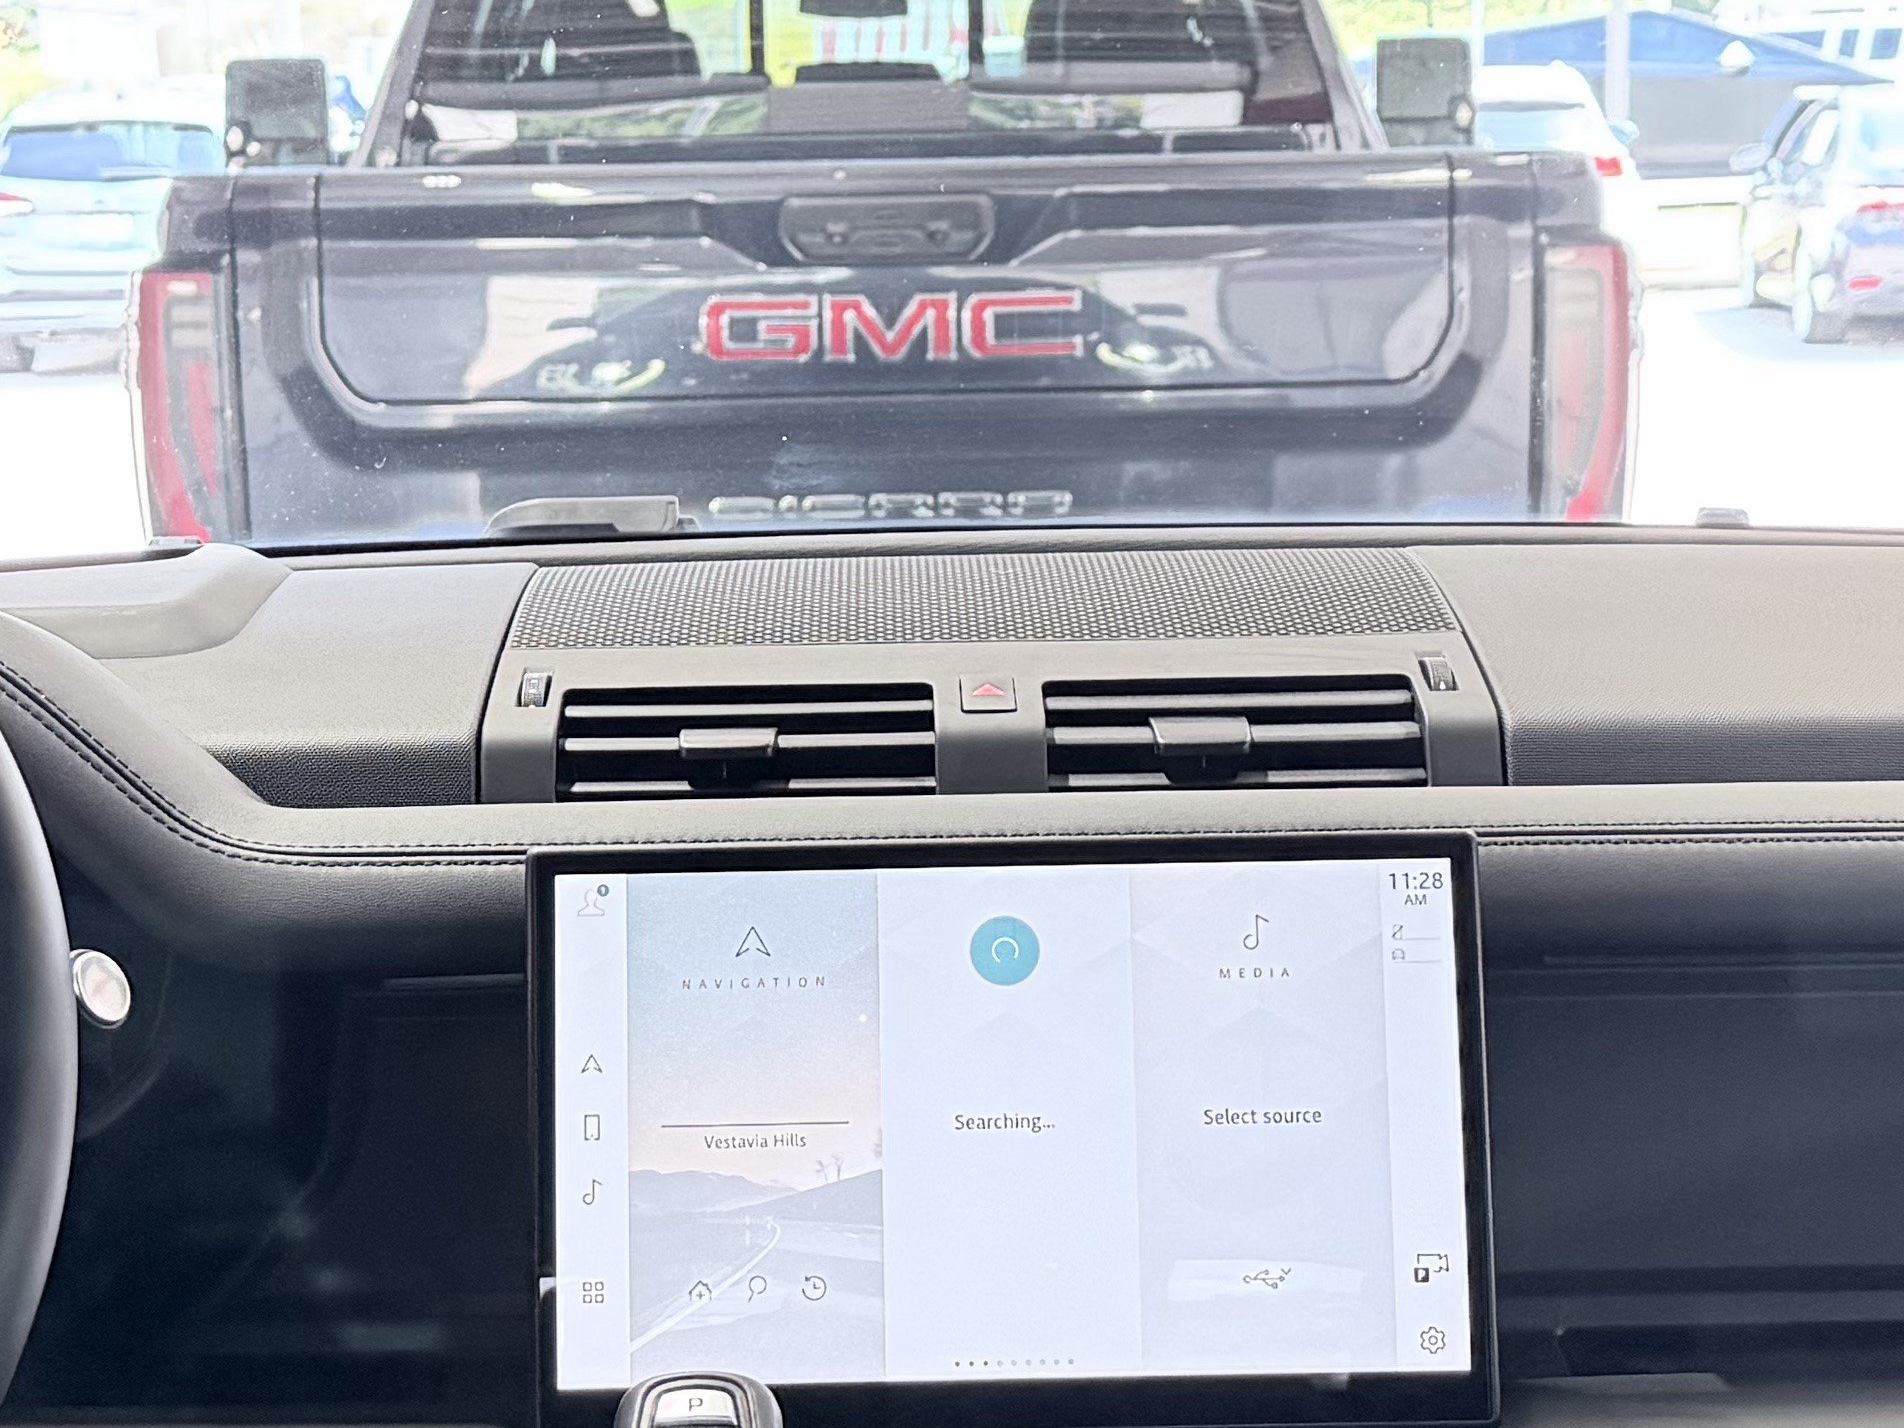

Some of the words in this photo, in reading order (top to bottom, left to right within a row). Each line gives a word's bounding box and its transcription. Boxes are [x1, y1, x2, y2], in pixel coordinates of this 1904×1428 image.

[700, 290, 1084, 362] GMC
[1388, 871, 1444, 890] 11:28
[1404, 893, 1428, 906] AM
[1219, 967, 1290, 979] MEDIA
[682, 976, 826, 990] NAVIGATION
[954, 1113, 1056, 1134] Searching...
[1203, 1108, 1258, 1126] Select
[1263, 1108, 1323, 1125] source
[704, 1134, 769, 1150] Vestavia
[773, 1133, 807, 1148] Hills
[689, 1397, 703, 1412] P
